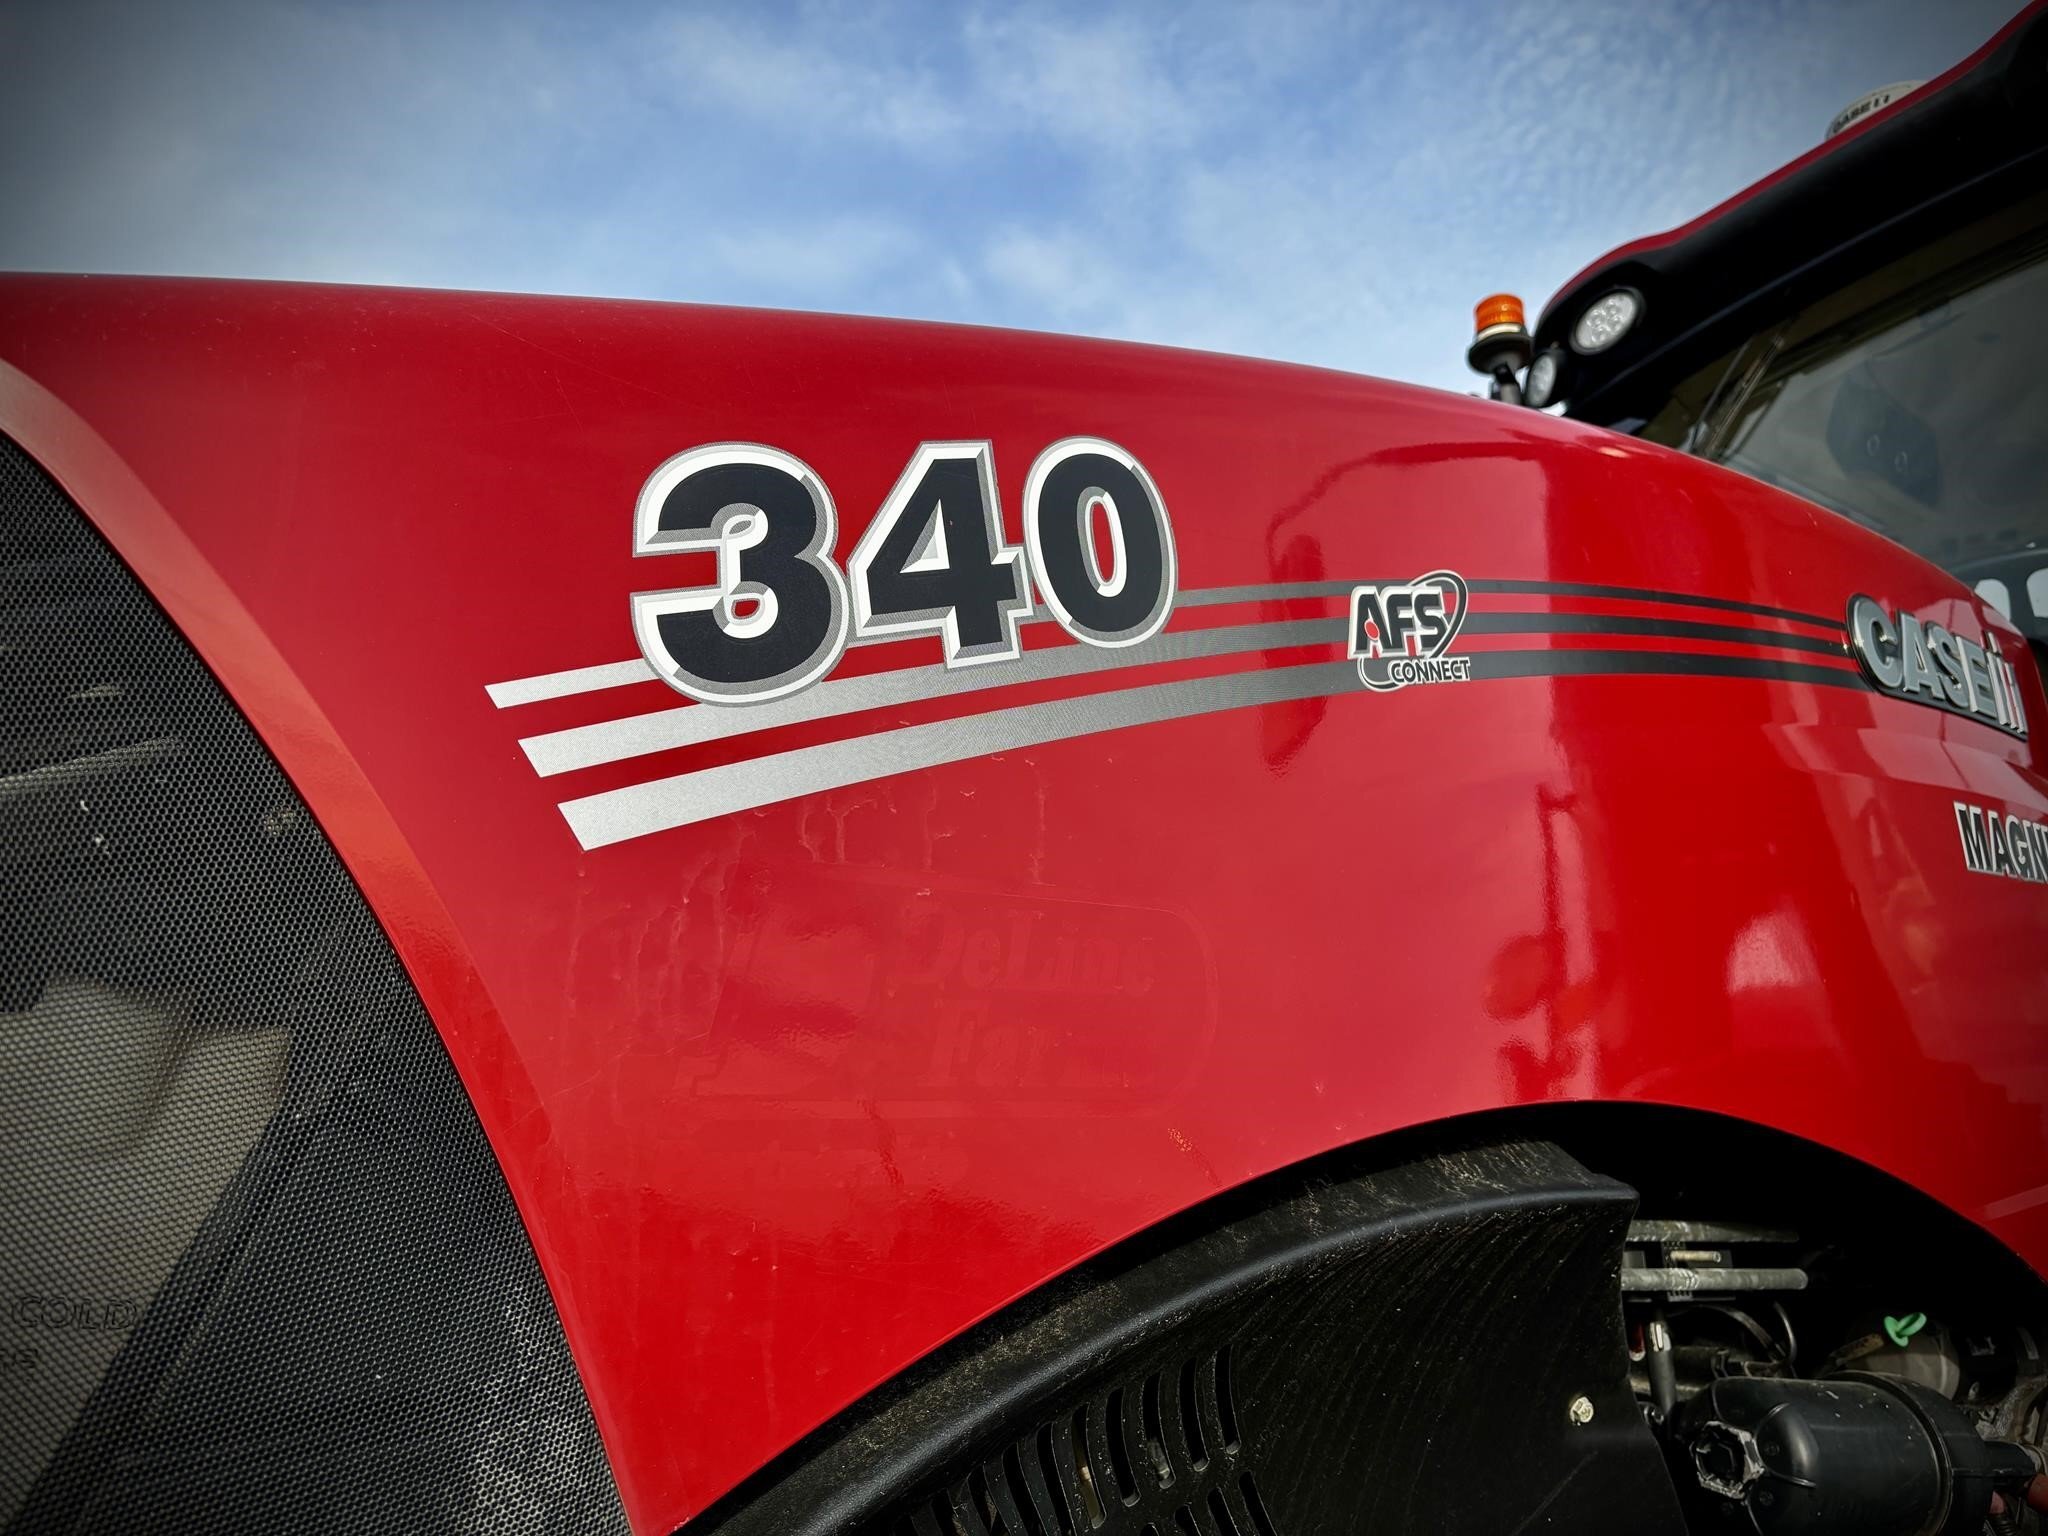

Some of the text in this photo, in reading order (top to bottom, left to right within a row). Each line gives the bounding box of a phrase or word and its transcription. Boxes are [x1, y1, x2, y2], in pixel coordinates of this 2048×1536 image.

[630, 435, 1178, 706] 340
[1347, 585, 1447, 660] AFS
[1848, 593, 1998, 719] CASE
[1388, 657, 1471, 686] CONNECT
[1953, 800, 2048, 884] MAGN
